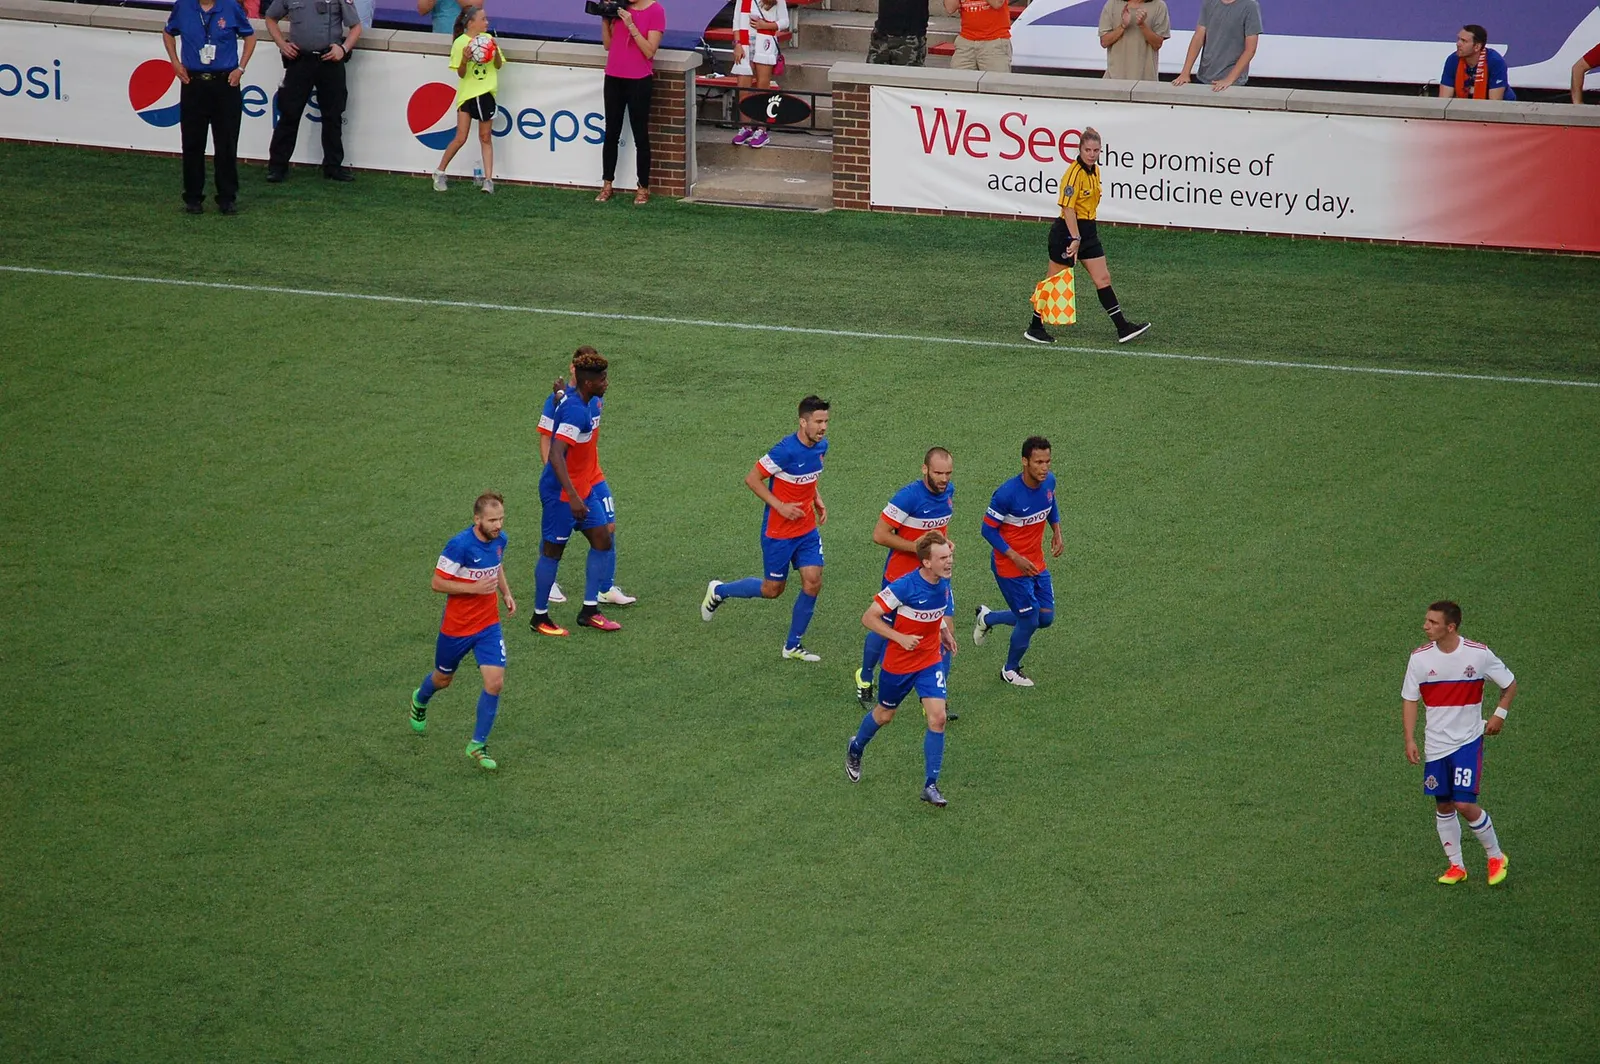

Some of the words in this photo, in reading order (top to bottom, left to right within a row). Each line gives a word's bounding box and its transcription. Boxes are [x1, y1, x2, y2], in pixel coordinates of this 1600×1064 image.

[911, 105, 991, 158] We
[999, 111, 1081, 164] See
[1142, 151, 1241, 175] promise
[1248, 153, 1275, 177] of
[1110, 179, 1223, 206] medicine
[1230, 189, 1298, 216] every
[1305, 188, 1355, 219] day.
[1454, 767, 1473, 788] 53
